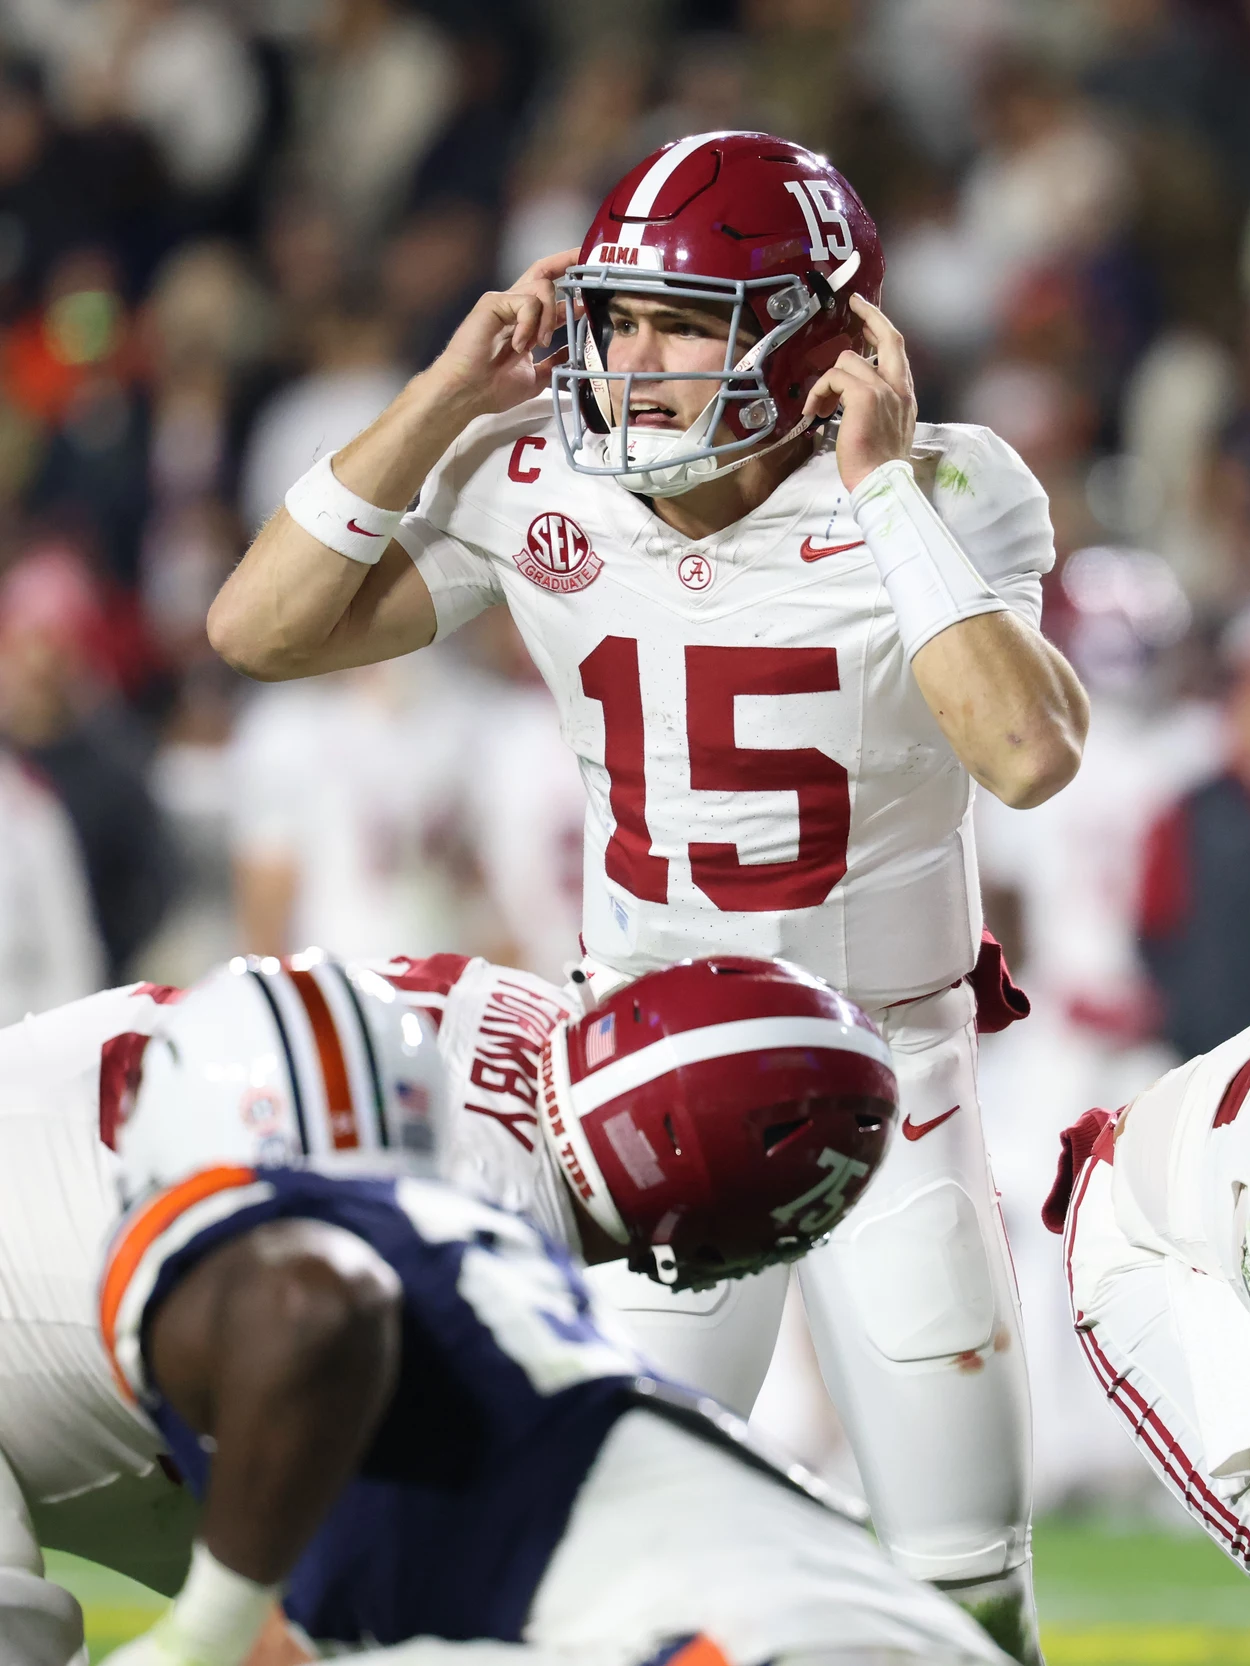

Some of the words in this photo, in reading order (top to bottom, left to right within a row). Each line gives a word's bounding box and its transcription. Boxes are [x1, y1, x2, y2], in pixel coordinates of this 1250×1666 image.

[783, 180, 854, 262] 15
[599, 245, 640, 266] BAMA
[508, 436, 547, 482] C
[530, 515, 584, 571] SEC
[524, 564, 593, 591] GRADUATE
[578, 634, 851, 912] 15
[464, 980, 570, 1153] FORMBY
[561, 1141, 595, 1200] TIDE
[769, 1146, 869, 1232] 75
